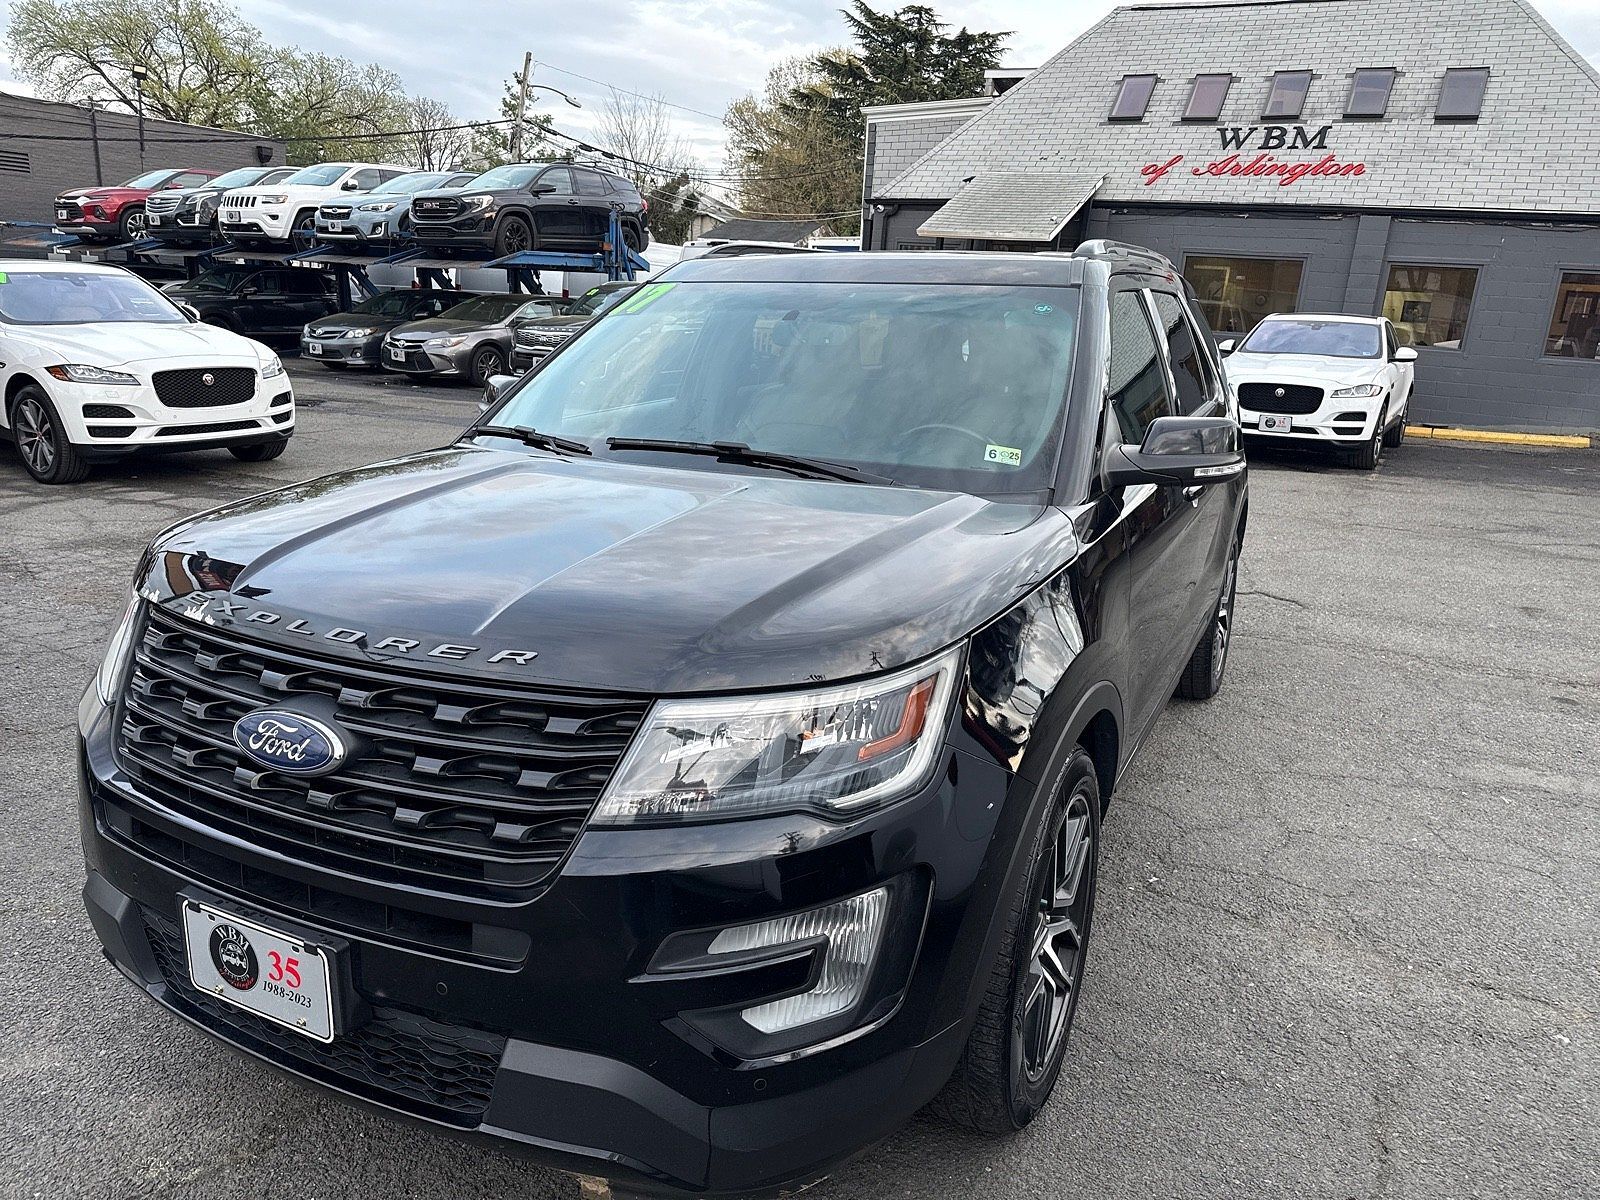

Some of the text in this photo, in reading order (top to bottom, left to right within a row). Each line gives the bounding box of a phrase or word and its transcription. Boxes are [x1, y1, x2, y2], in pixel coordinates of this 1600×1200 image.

[1216, 125, 1332, 151] WBM
[1141, 153, 1366, 187] of Arlington
[988, 449, 1020, 461] 6 25
[184, 590, 539, 666] EXPLORER
[249, 719, 306, 763] Ford
[215, 925, 250, 951] WBM
[267, 950, 302, 989] 35
[262, 981, 312, 1009] 1988-2023
